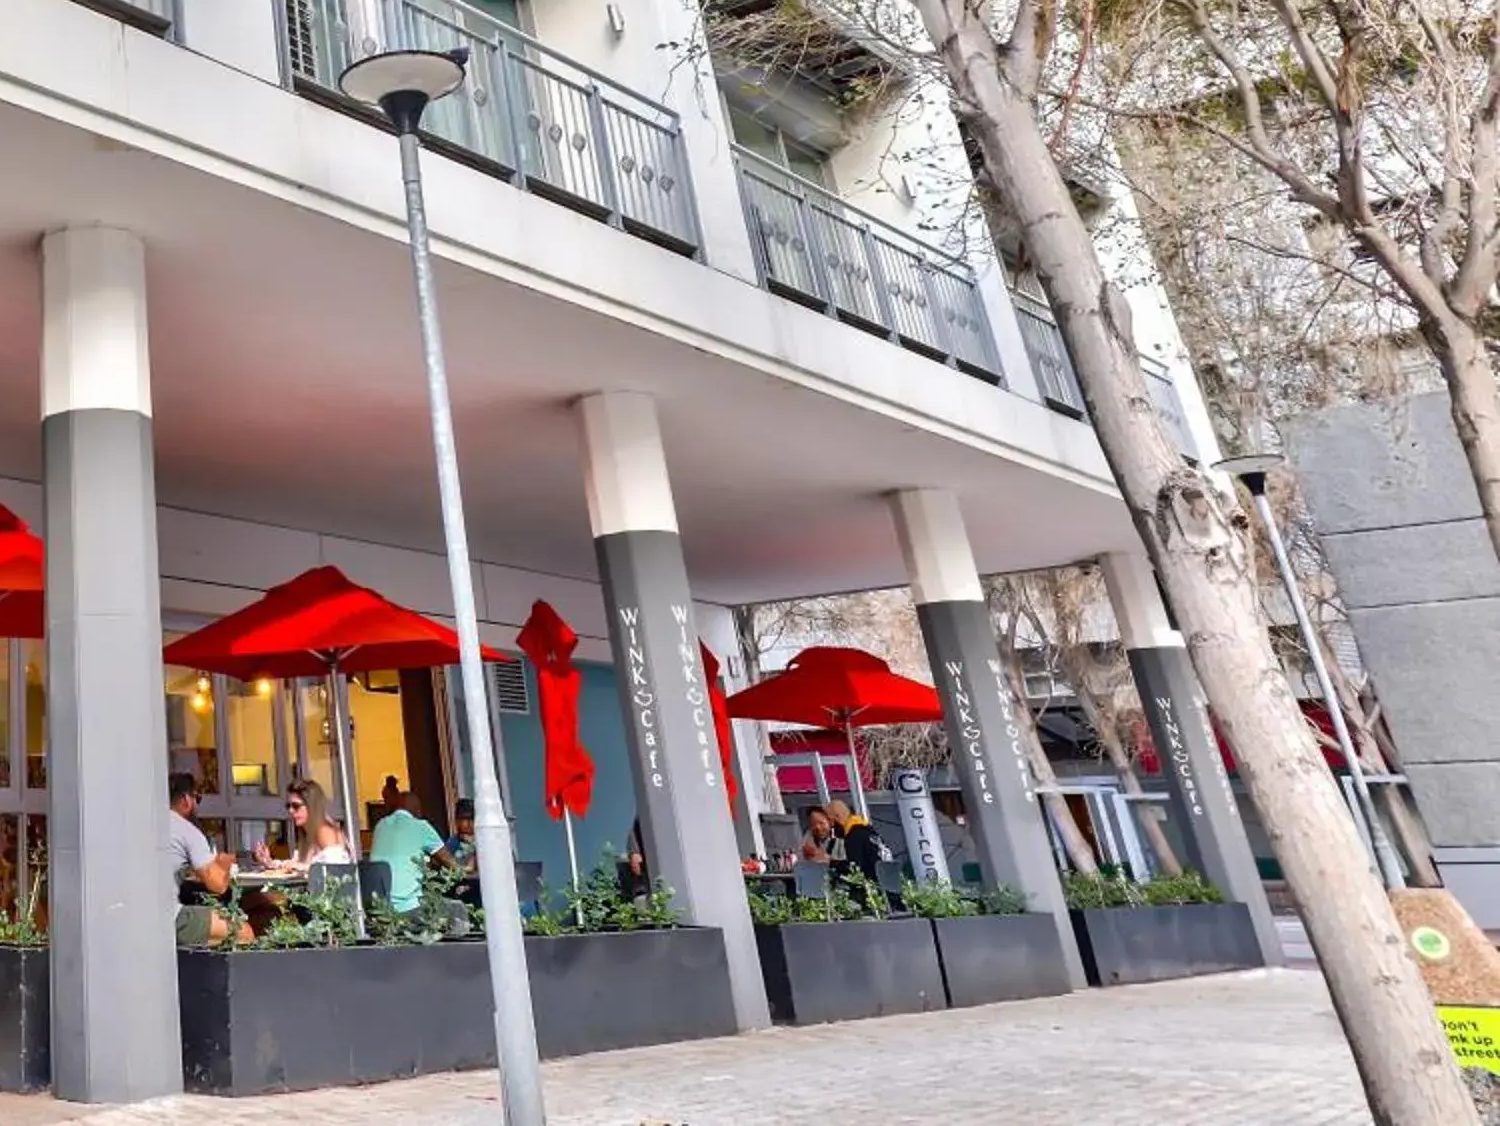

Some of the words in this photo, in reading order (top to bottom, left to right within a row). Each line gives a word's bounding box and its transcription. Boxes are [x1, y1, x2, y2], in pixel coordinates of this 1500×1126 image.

[671, 605, 698, 683] WINK
[620, 607, 647, 685] WINK
[641, 709, 663, 787] Cafe
[946, 661, 974, 723] WINK
